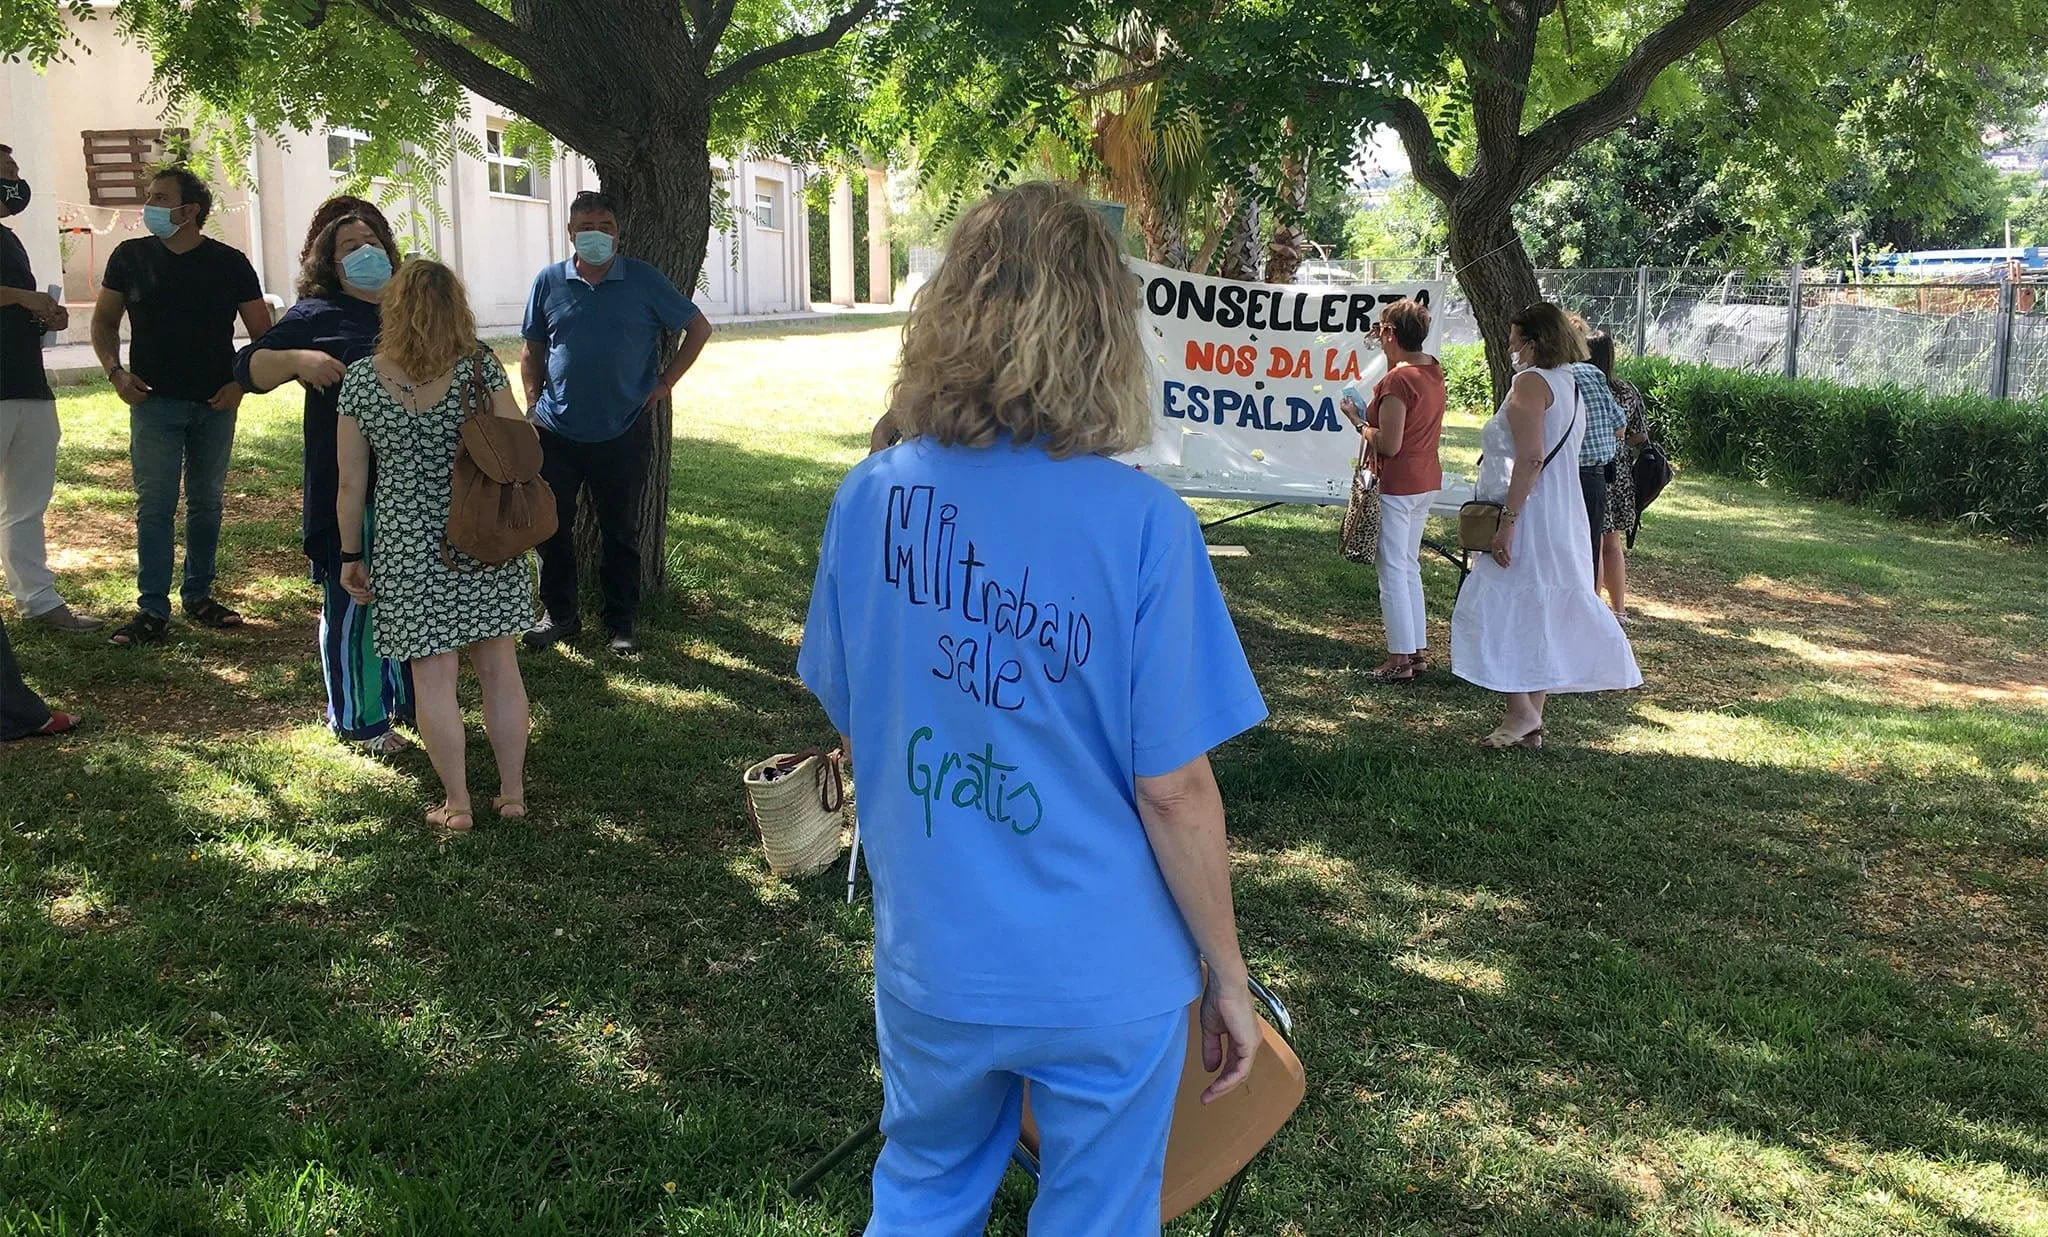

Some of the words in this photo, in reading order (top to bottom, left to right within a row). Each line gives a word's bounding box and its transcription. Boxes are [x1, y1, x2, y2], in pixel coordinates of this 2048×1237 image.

[1134, 273, 1431, 332] ONSELLER
[1185, 340, 1257, 377] NOS
[1266, 346, 1313, 379] DA
[1324, 348, 1361, 381] LA
[1163, 380, 1343, 432] ESPALDA
[958, 540, 1091, 683] trabajo
[932, 632, 1025, 710] sale
[907, 726, 1043, 838] Gratis
